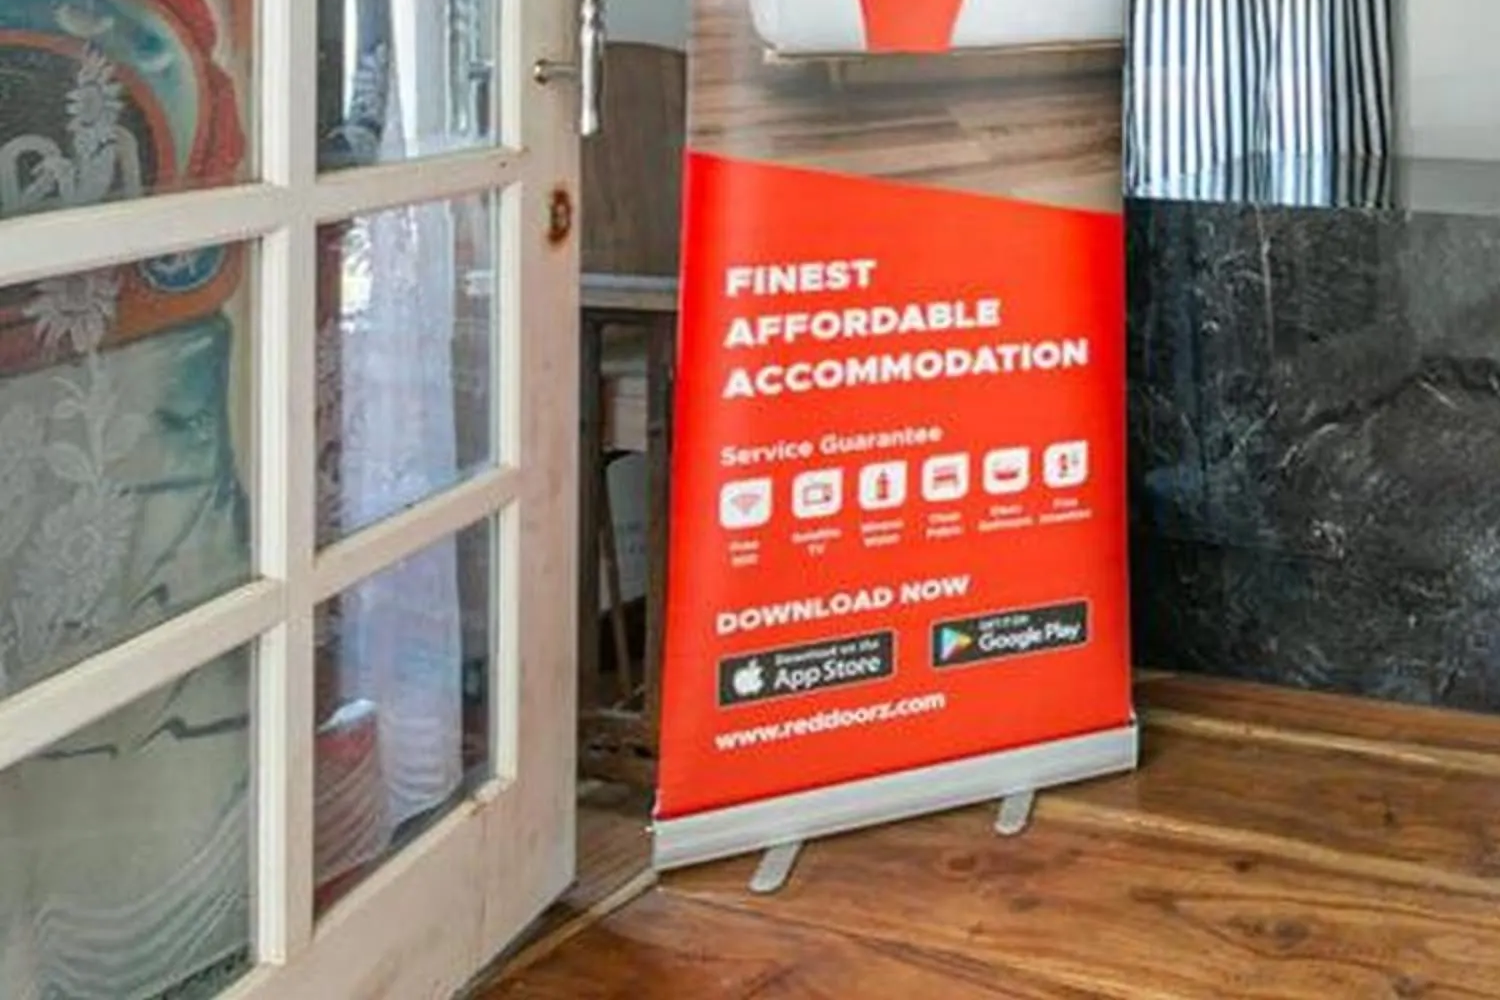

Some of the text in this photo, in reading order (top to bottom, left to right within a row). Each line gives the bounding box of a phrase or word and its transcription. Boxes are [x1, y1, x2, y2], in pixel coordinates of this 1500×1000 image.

[725, 259, 877, 298] FINEST
[722, 298, 1002, 349] AFFORDABLE
[722, 337, 1090, 400] ACCOMMODATION
[720, 426, 944, 467] Service Guarantee
[716, 575, 972, 636] DOWNLOAD NOW
[977, 620, 1082, 651] Google Play
[773, 655, 882, 691] App Store
[714, 692, 946, 750] www.reddoorz.com
